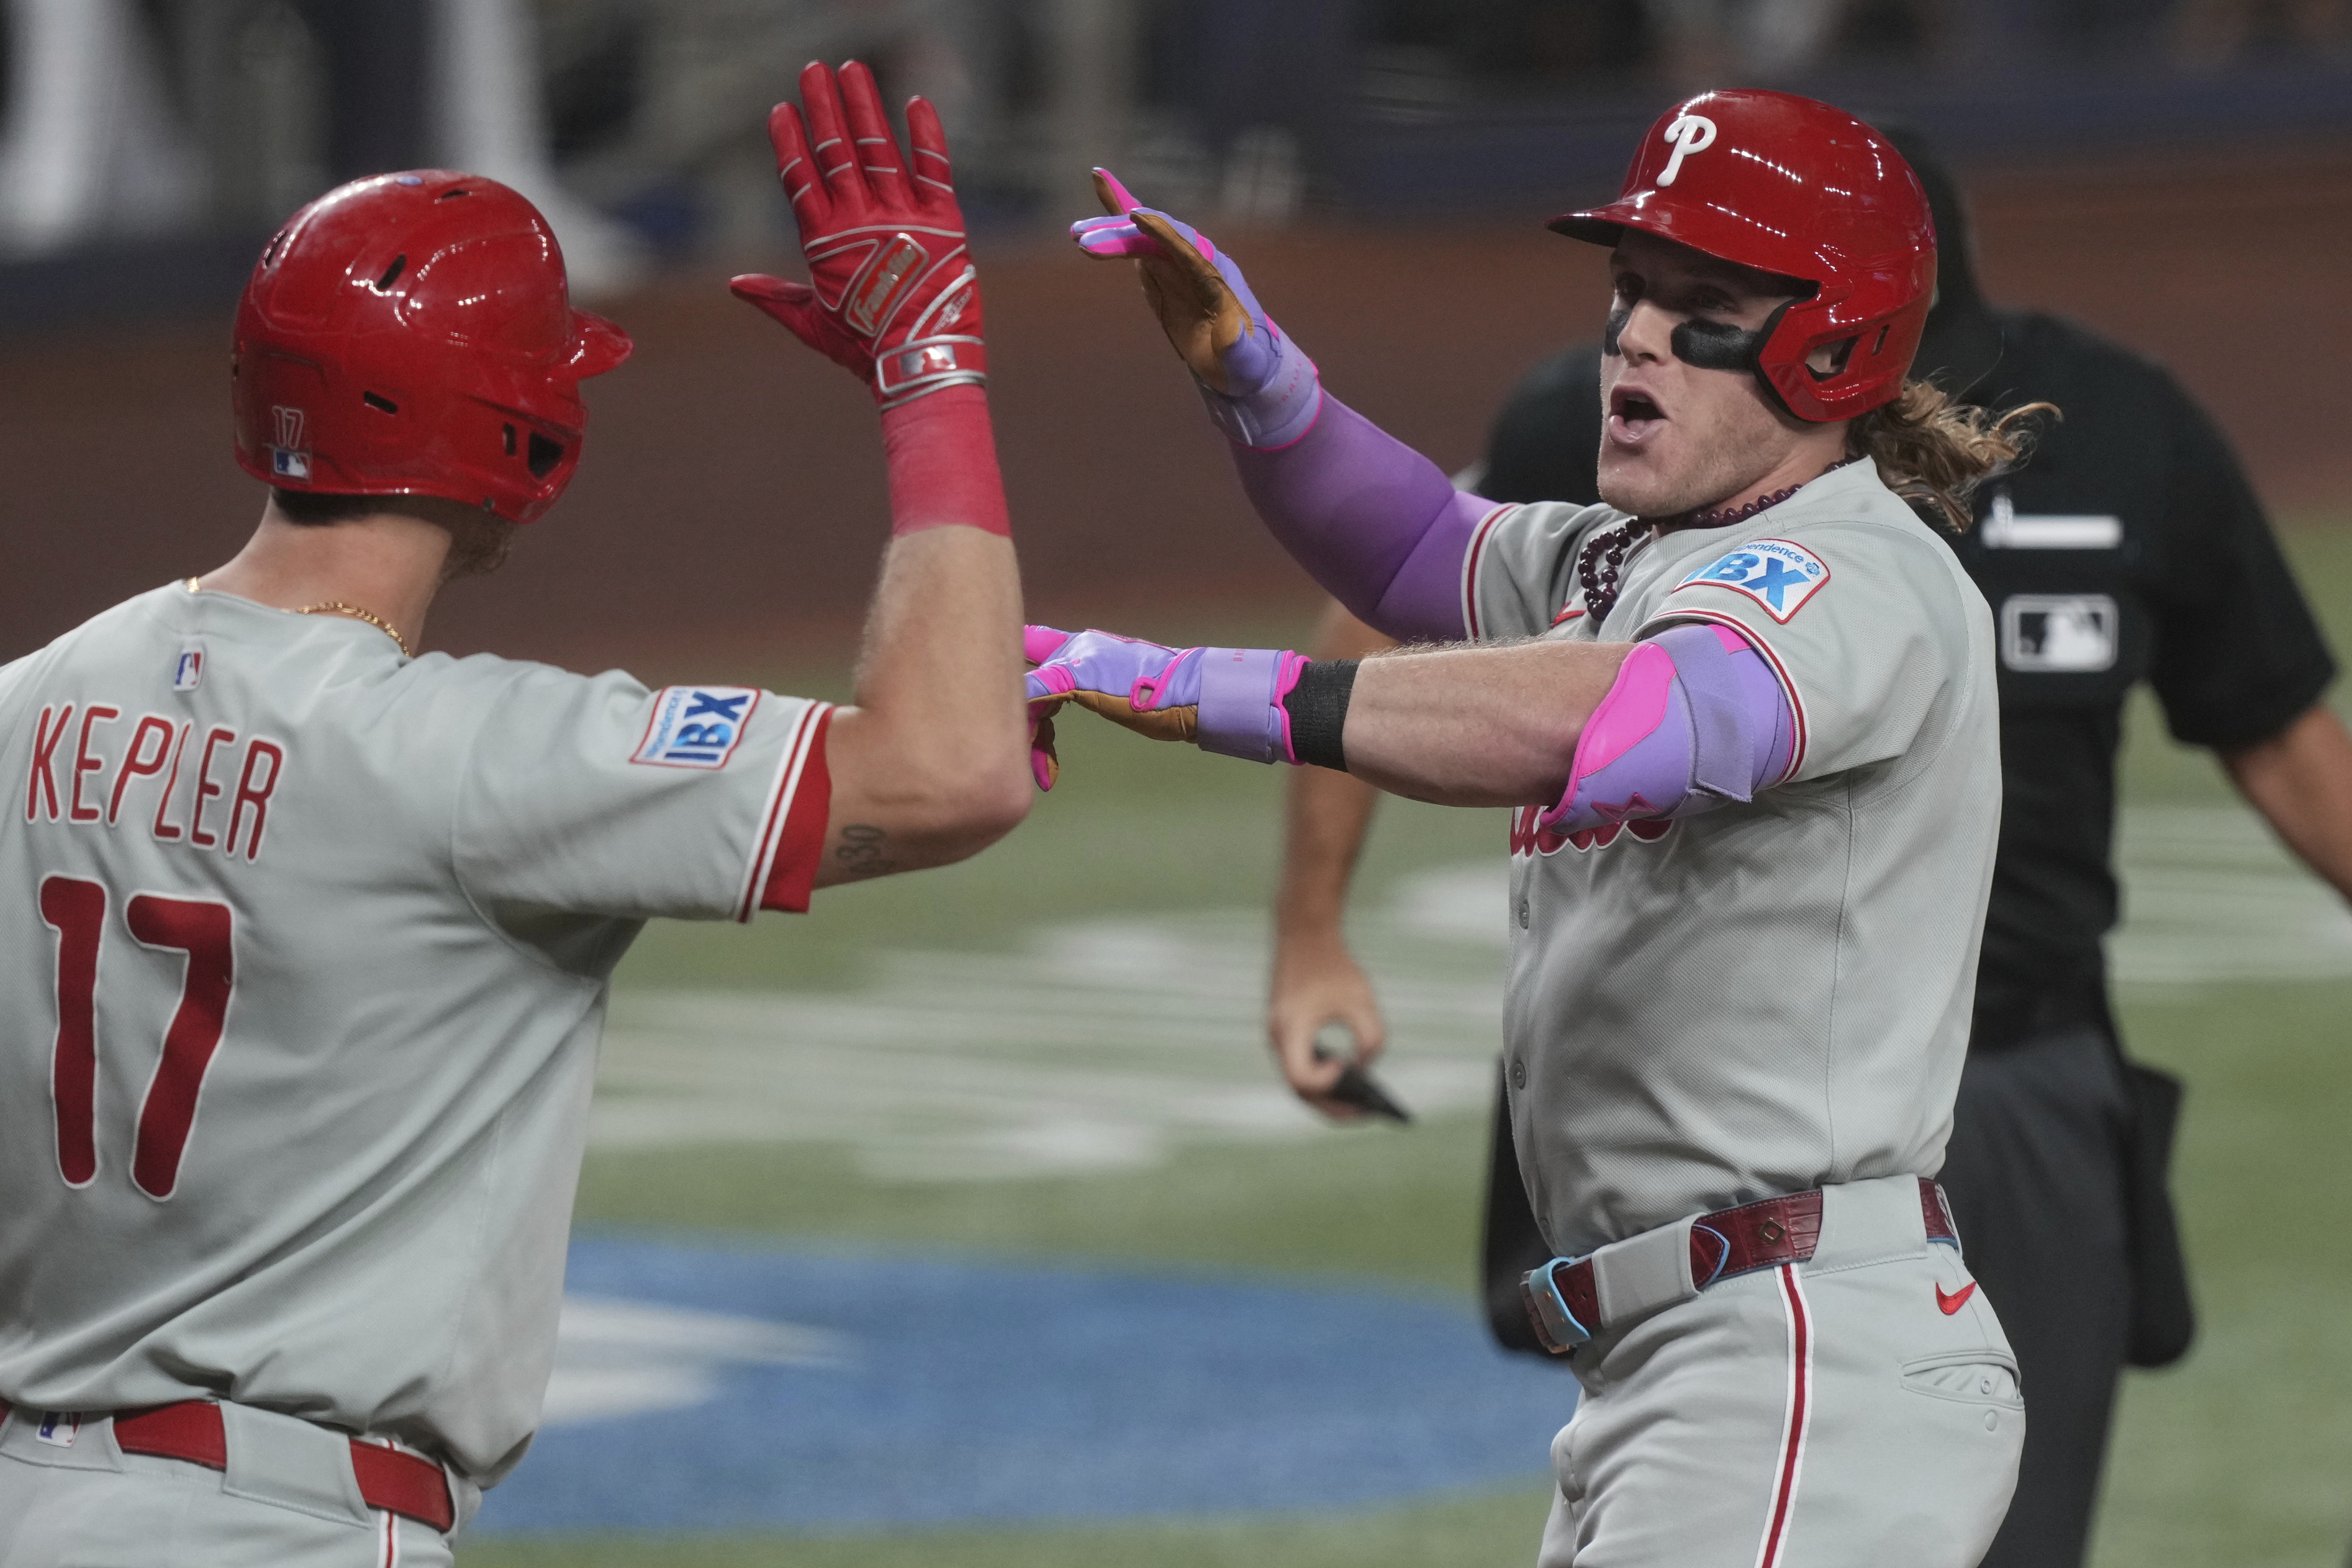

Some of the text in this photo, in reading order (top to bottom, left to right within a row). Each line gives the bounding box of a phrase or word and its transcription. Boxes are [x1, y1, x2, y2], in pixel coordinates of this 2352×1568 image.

[1656, 115, 1717, 187] P
[271, 405, 304, 451] 17
[664, 691, 749, 762] IBX
[26, 700, 286, 863] KEPLER
[38, 873, 237, 1202] 17
